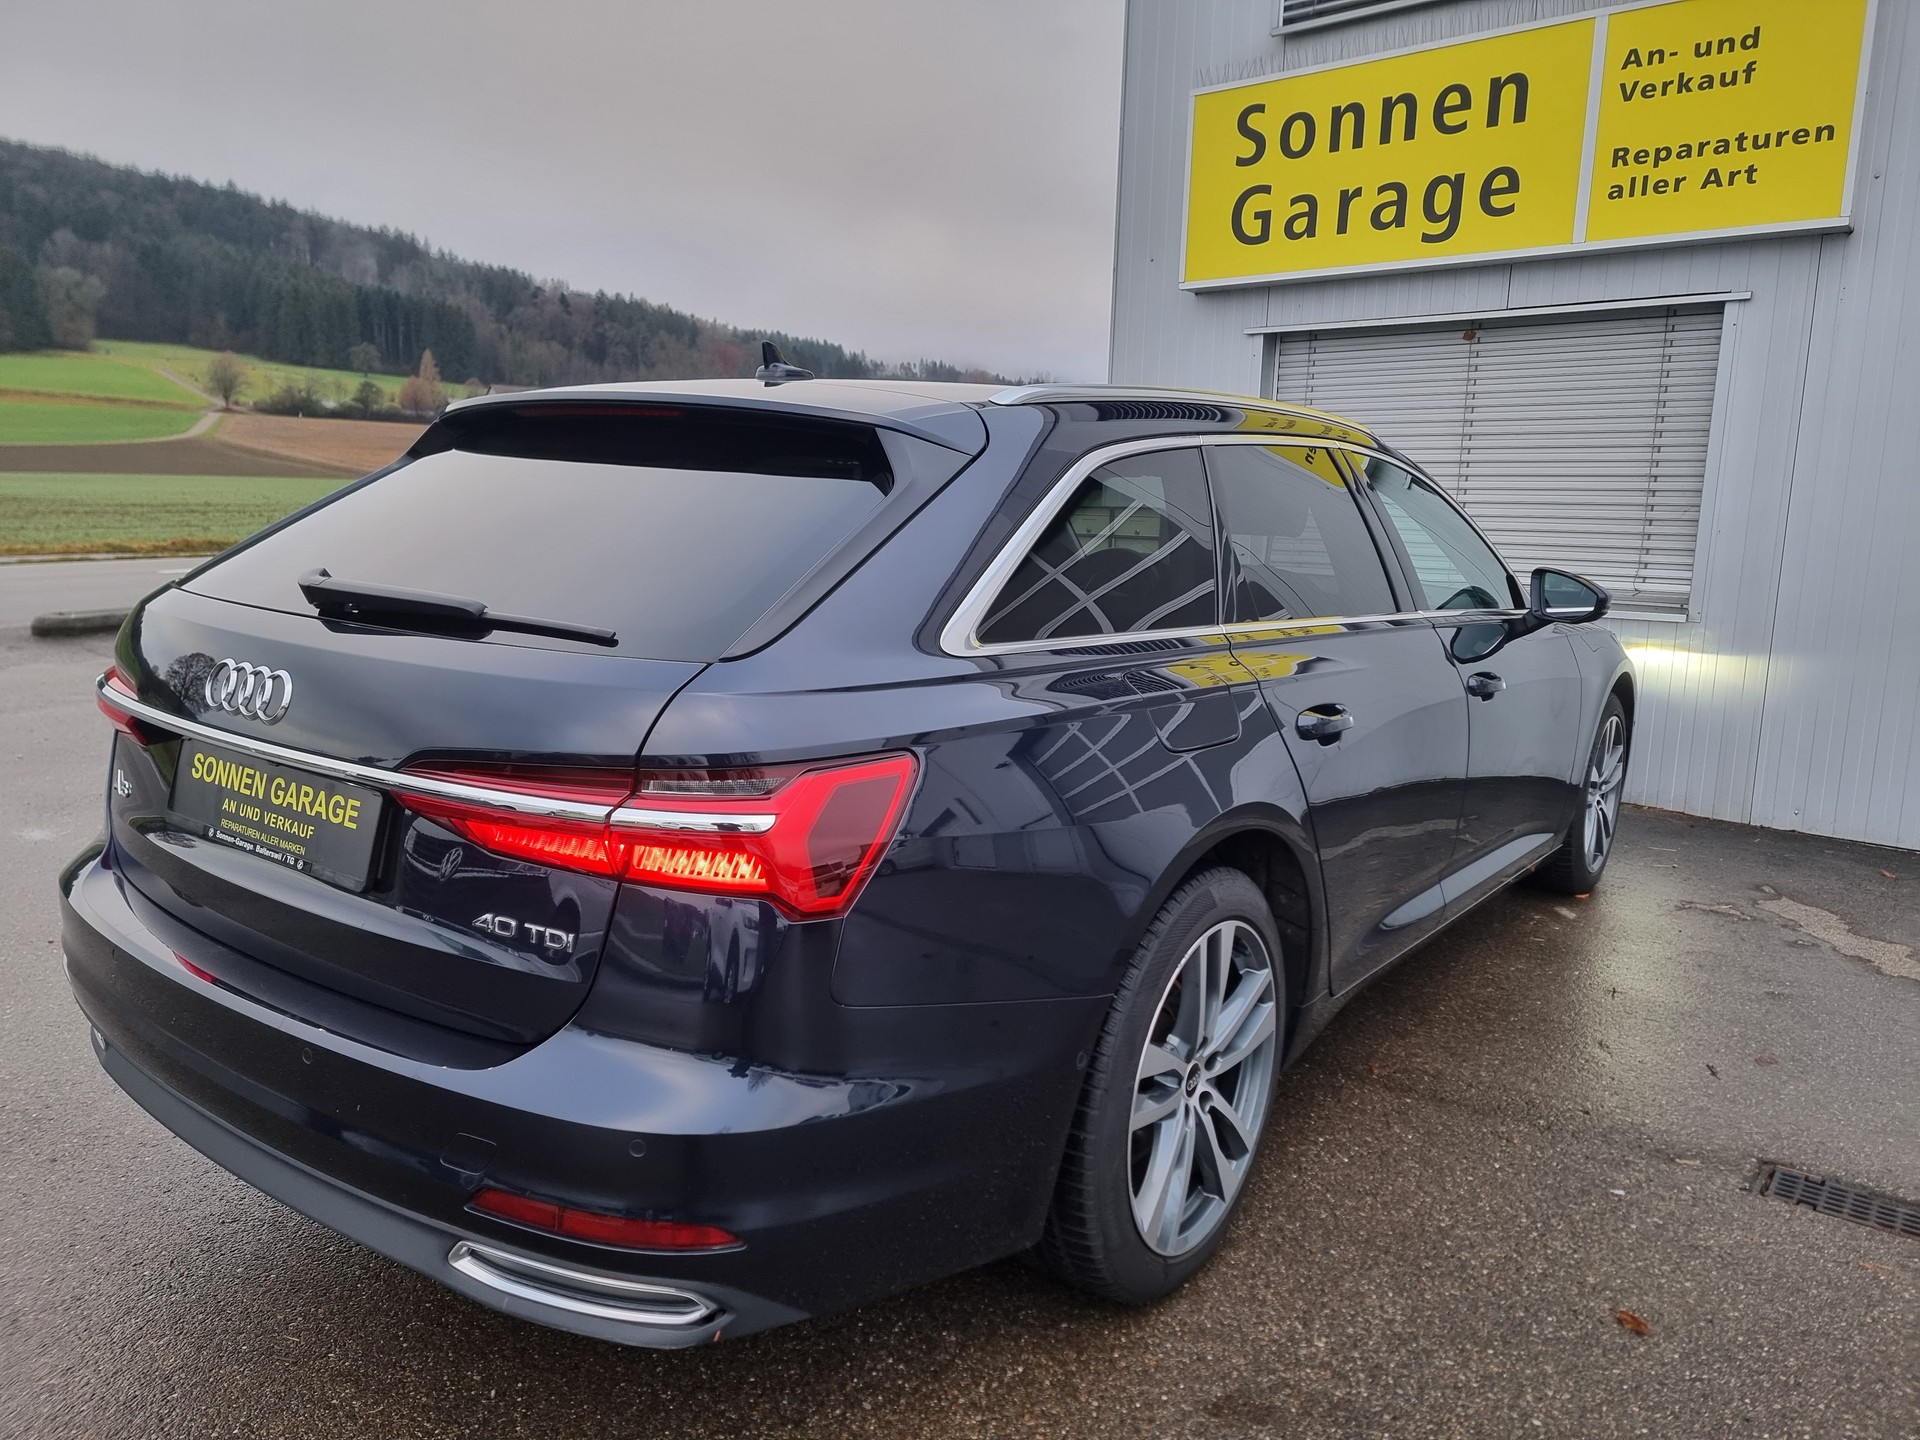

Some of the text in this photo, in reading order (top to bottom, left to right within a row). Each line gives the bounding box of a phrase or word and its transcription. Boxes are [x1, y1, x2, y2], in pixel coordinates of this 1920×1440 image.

[1620, 26, 1761, 70] An- und
[1619, 60, 1758, 102] Verkauf
[1235, 72, 1529, 167] Sonnen
[1611, 123, 1836, 168] Reparaturen
[1607, 164, 1758, 200] aller Art
[1231, 165, 1520, 245] Garage
[191, 753, 361, 830] SONNEN GARAGE
[220, 818, 306, 856] REPARATUREN ALLER MARKEN
[222, 798, 315, 839] AN UND VERKAUF
[286, 855, 295, 865] TG
[472, 913, 575, 953] 40 TDI
